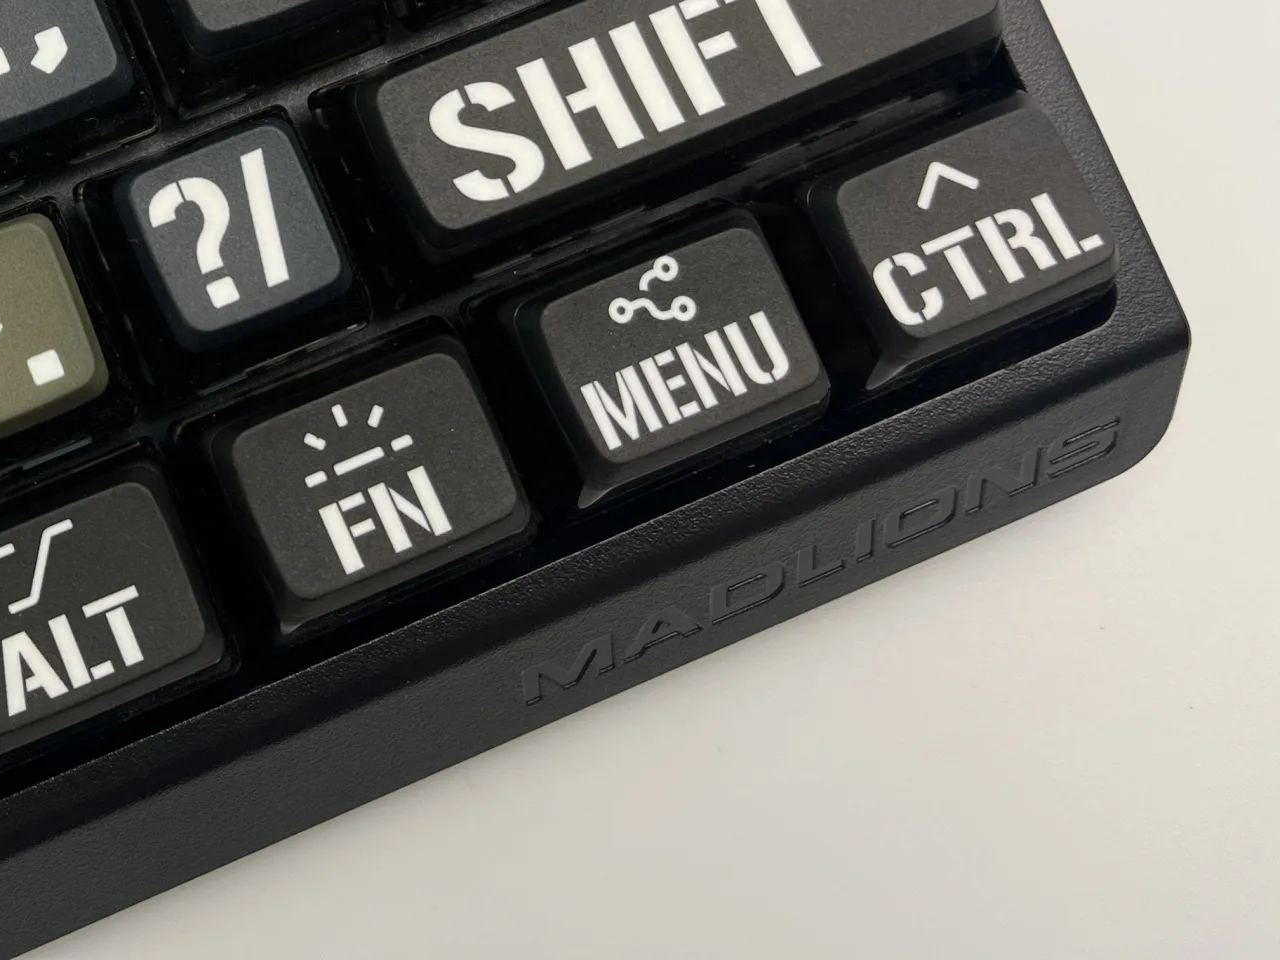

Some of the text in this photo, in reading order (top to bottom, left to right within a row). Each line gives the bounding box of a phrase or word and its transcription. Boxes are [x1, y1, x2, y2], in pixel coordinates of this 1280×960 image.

[873, 192, 1104, 326] CTRL
[581, 310, 790, 451] MENU
[319, 466, 452, 575] FN
[521, 413, 1121, 707] MADLIONS
[2, 585, 144, 717] ALT
